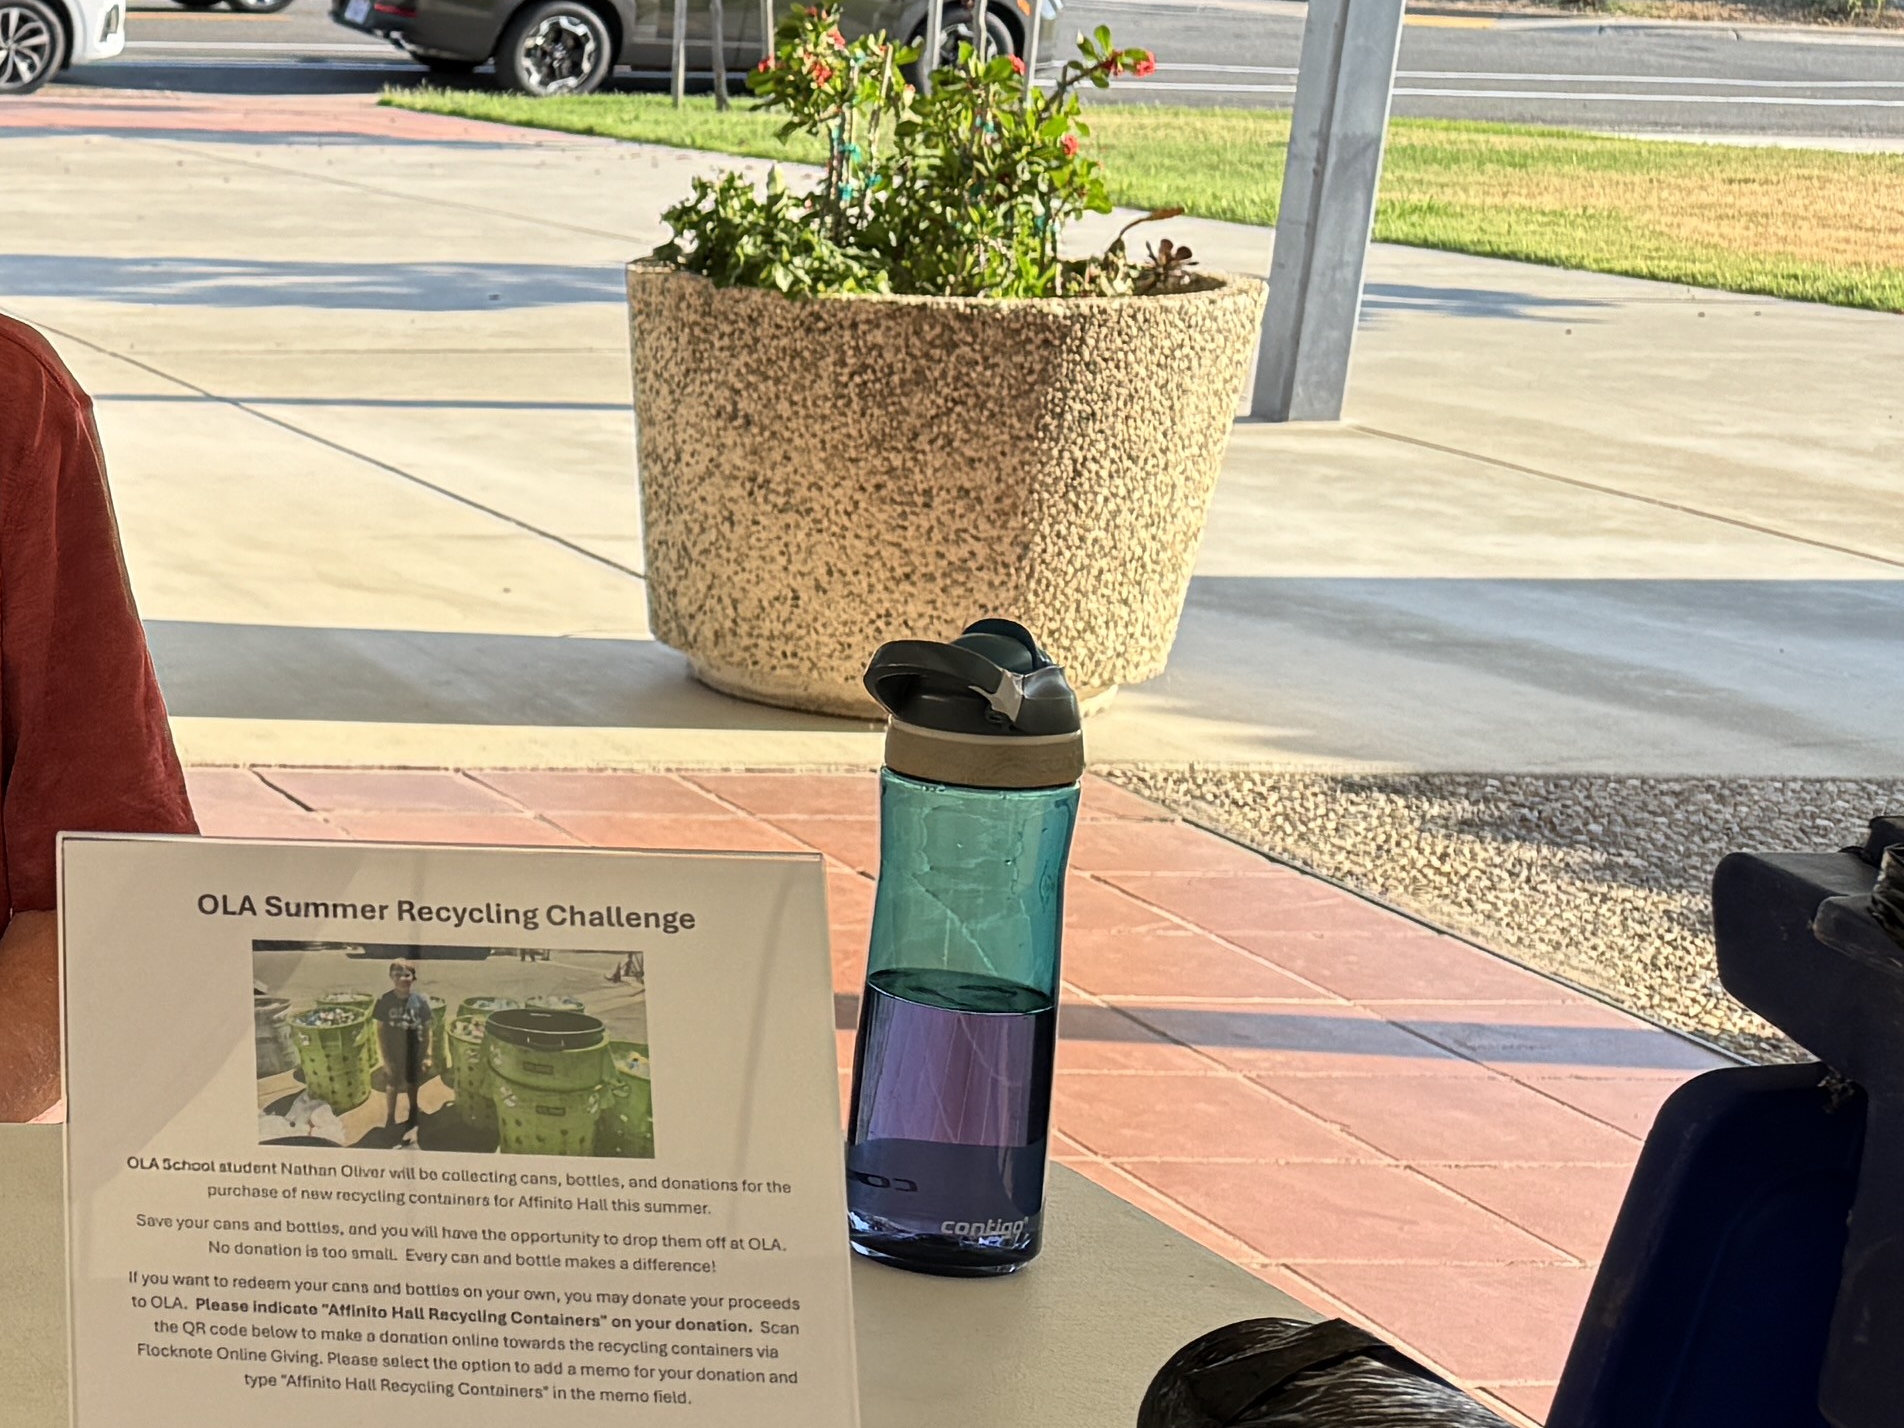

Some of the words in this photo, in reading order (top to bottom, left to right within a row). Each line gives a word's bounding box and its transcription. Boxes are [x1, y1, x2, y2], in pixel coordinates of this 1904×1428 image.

[197, 893, 257, 916] OLA
[265, 895, 388, 920] Summer
[397, 899, 539, 930] Recycling
[545, 904, 695, 934] Challenge
[126, 1156, 159, 1170] OLA
[162, 1157, 215, 1172] School
[219, 1161, 276, 1174] student
[280, 1162, 336, 1176] Nathan
[340, 1164, 385, 1178] Oliver
[388, 1167, 415, 1179] will
[419, 1167, 438, 1181] be
[441, 1169, 517, 1186] collecting
[520, 1174, 561, 1187] cans,
[566, 1173, 624, 1189] bottles,
[628, 1176, 657, 1188] and
[661, 1177, 738, 1191] donations
[741, 1179, 762, 1192] for
[766, 1180, 791, 1193] the
[941, 1218, 1023, 1239] contigo
[208, 1240, 230, 1254] No
[234, 1242, 301, 1256] donation
[305, 1244, 318, 1257] is
[321, 1246, 347, 1258] too
[351, 1247, 397, 1260] small.
[405, 1248, 447, 1265] Every
[450, 1253, 479, 1263] can
[483, 1253, 511, 1265] and
[515, 1253, 561, 1267] bottle
[565, 1255, 615, 1269] makes
[619, 1259, 628, 1269] a
[632, 1257, 715, 1273] difference!
